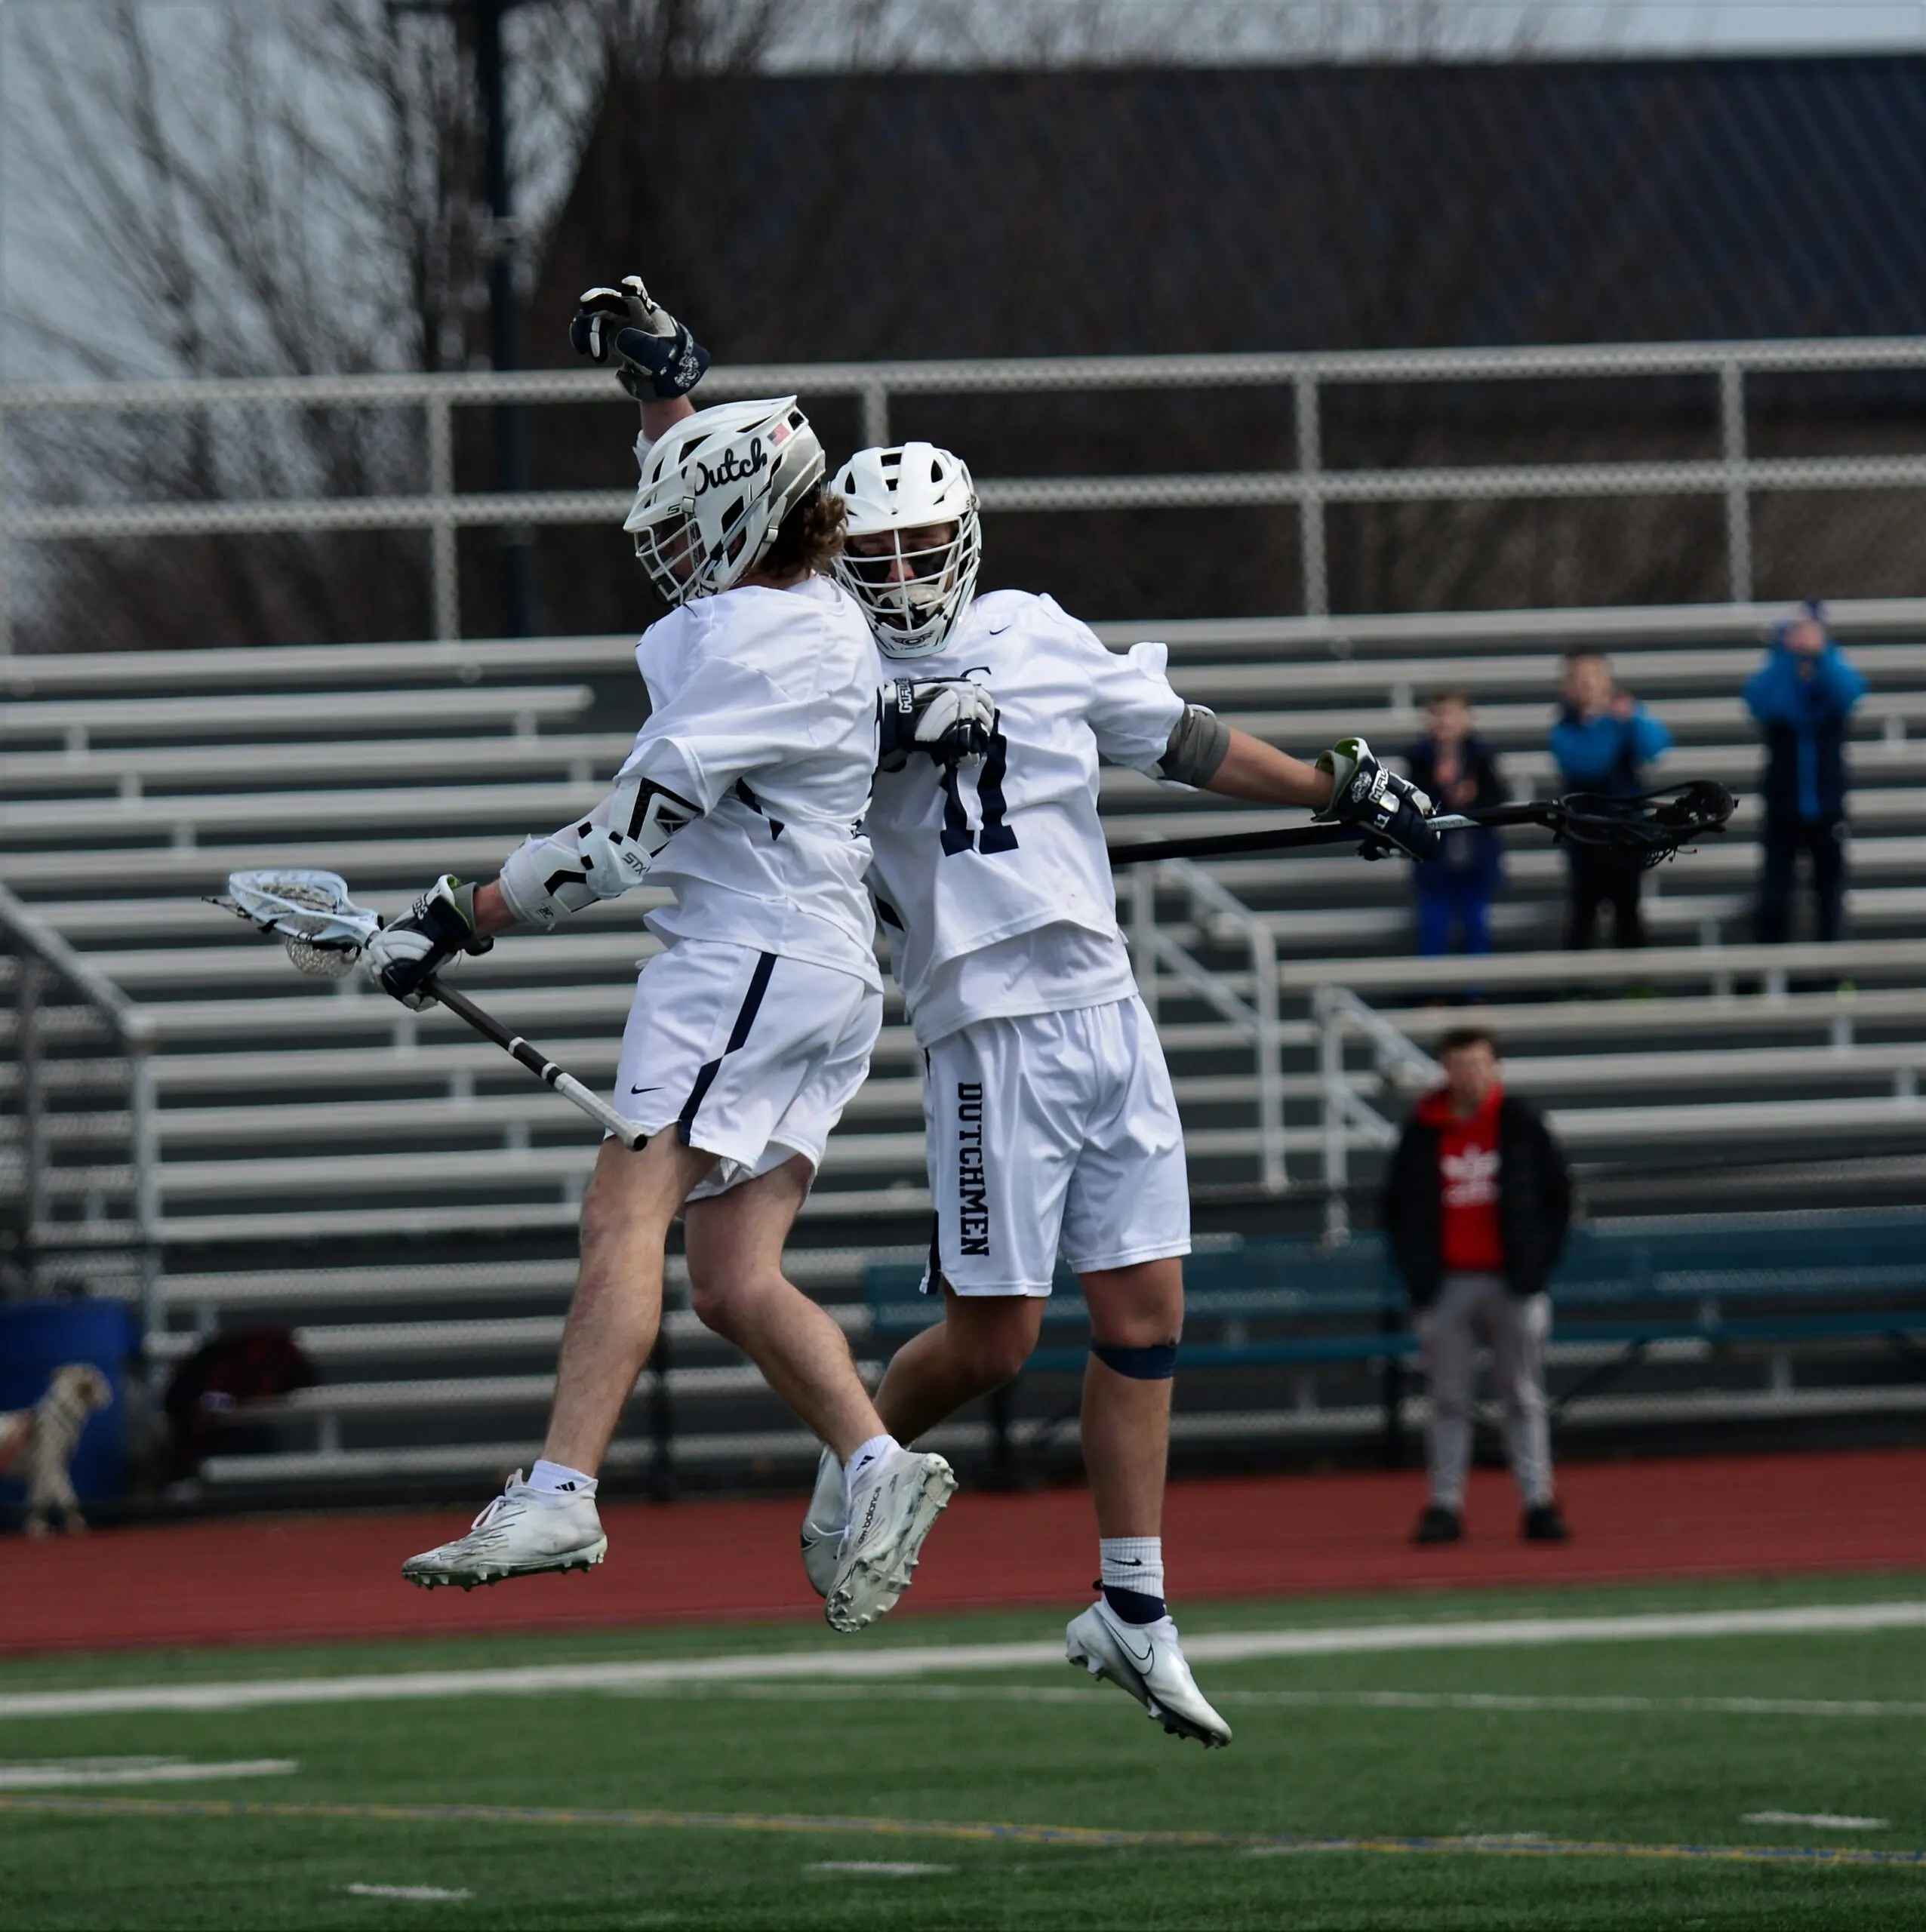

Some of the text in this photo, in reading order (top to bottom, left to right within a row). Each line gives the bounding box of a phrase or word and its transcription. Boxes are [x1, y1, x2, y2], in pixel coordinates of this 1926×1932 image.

[681, 437, 768, 495] Dutch
[622, 852, 647, 875] STX
[958, 1082, 989, 1257] DUTCHMEN
